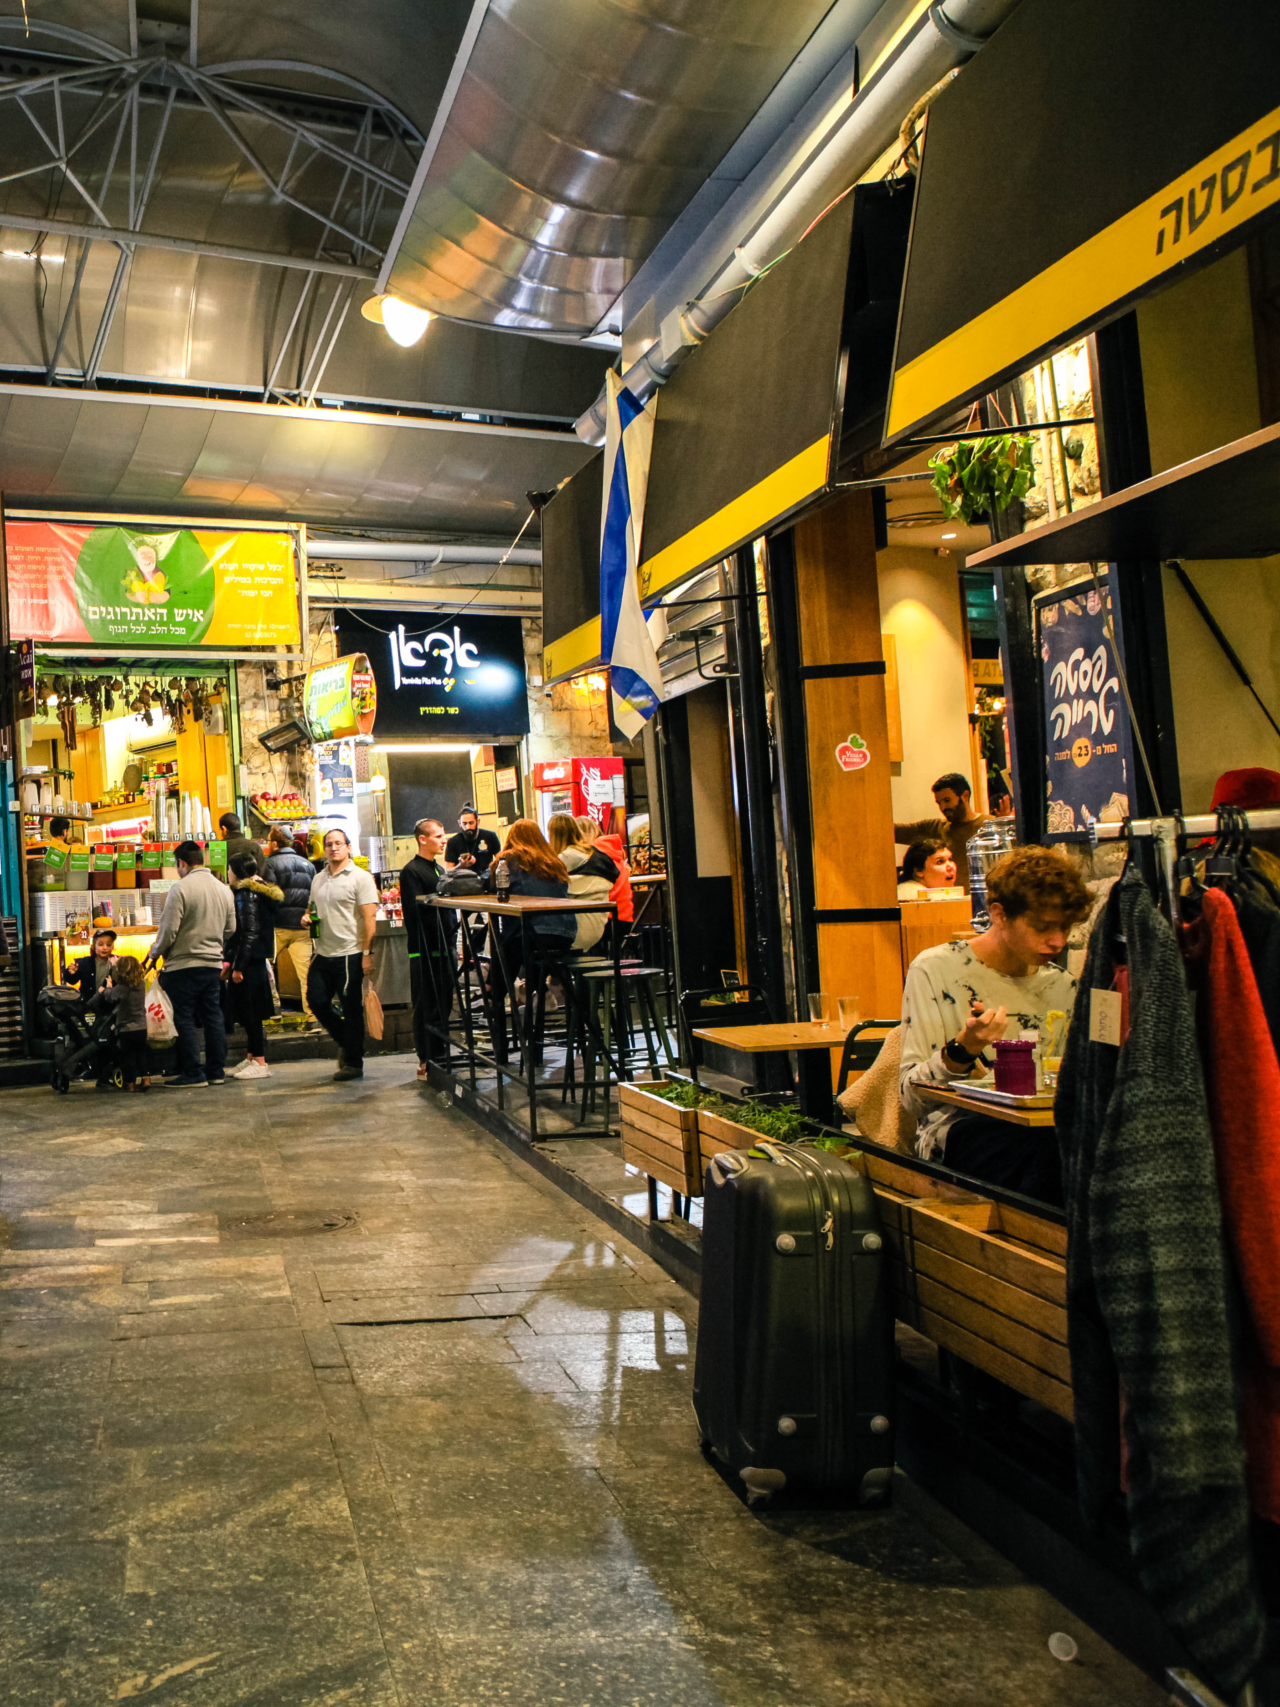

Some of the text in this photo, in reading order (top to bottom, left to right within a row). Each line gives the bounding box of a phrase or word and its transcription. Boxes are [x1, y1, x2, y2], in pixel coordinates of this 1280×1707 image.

[1156, 129, 1280, 257] בסטה
[88, 605, 204, 622] איש האתרוגים
[108, 624, 128, 636] הגוף
[130, 622, 147, 634] לכל
[169, 623, 186, 635] מכל
[1050, 645, 1107, 699] פסטה
[1050, 676, 1120, 741] טרייה
[210, 832, 217, 840] 3
